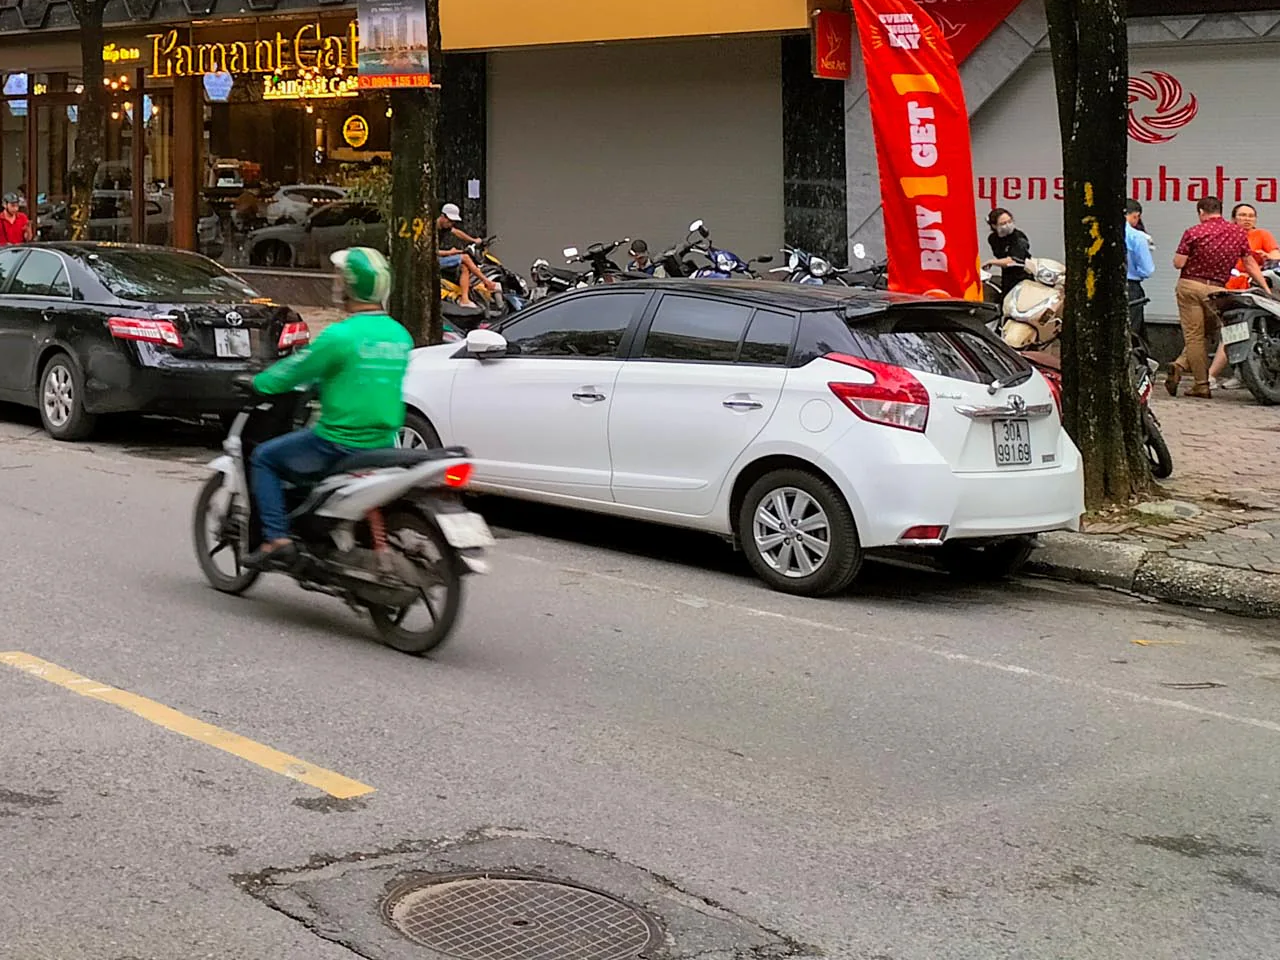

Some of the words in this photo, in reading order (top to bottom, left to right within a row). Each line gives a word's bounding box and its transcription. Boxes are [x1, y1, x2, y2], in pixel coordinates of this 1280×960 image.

[907, 100, 938, 168] GET
[915, 204, 948, 273] BUY
[997, 443, 1030, 462] 991.69
[1003, 423, 1022, 442] 30A
